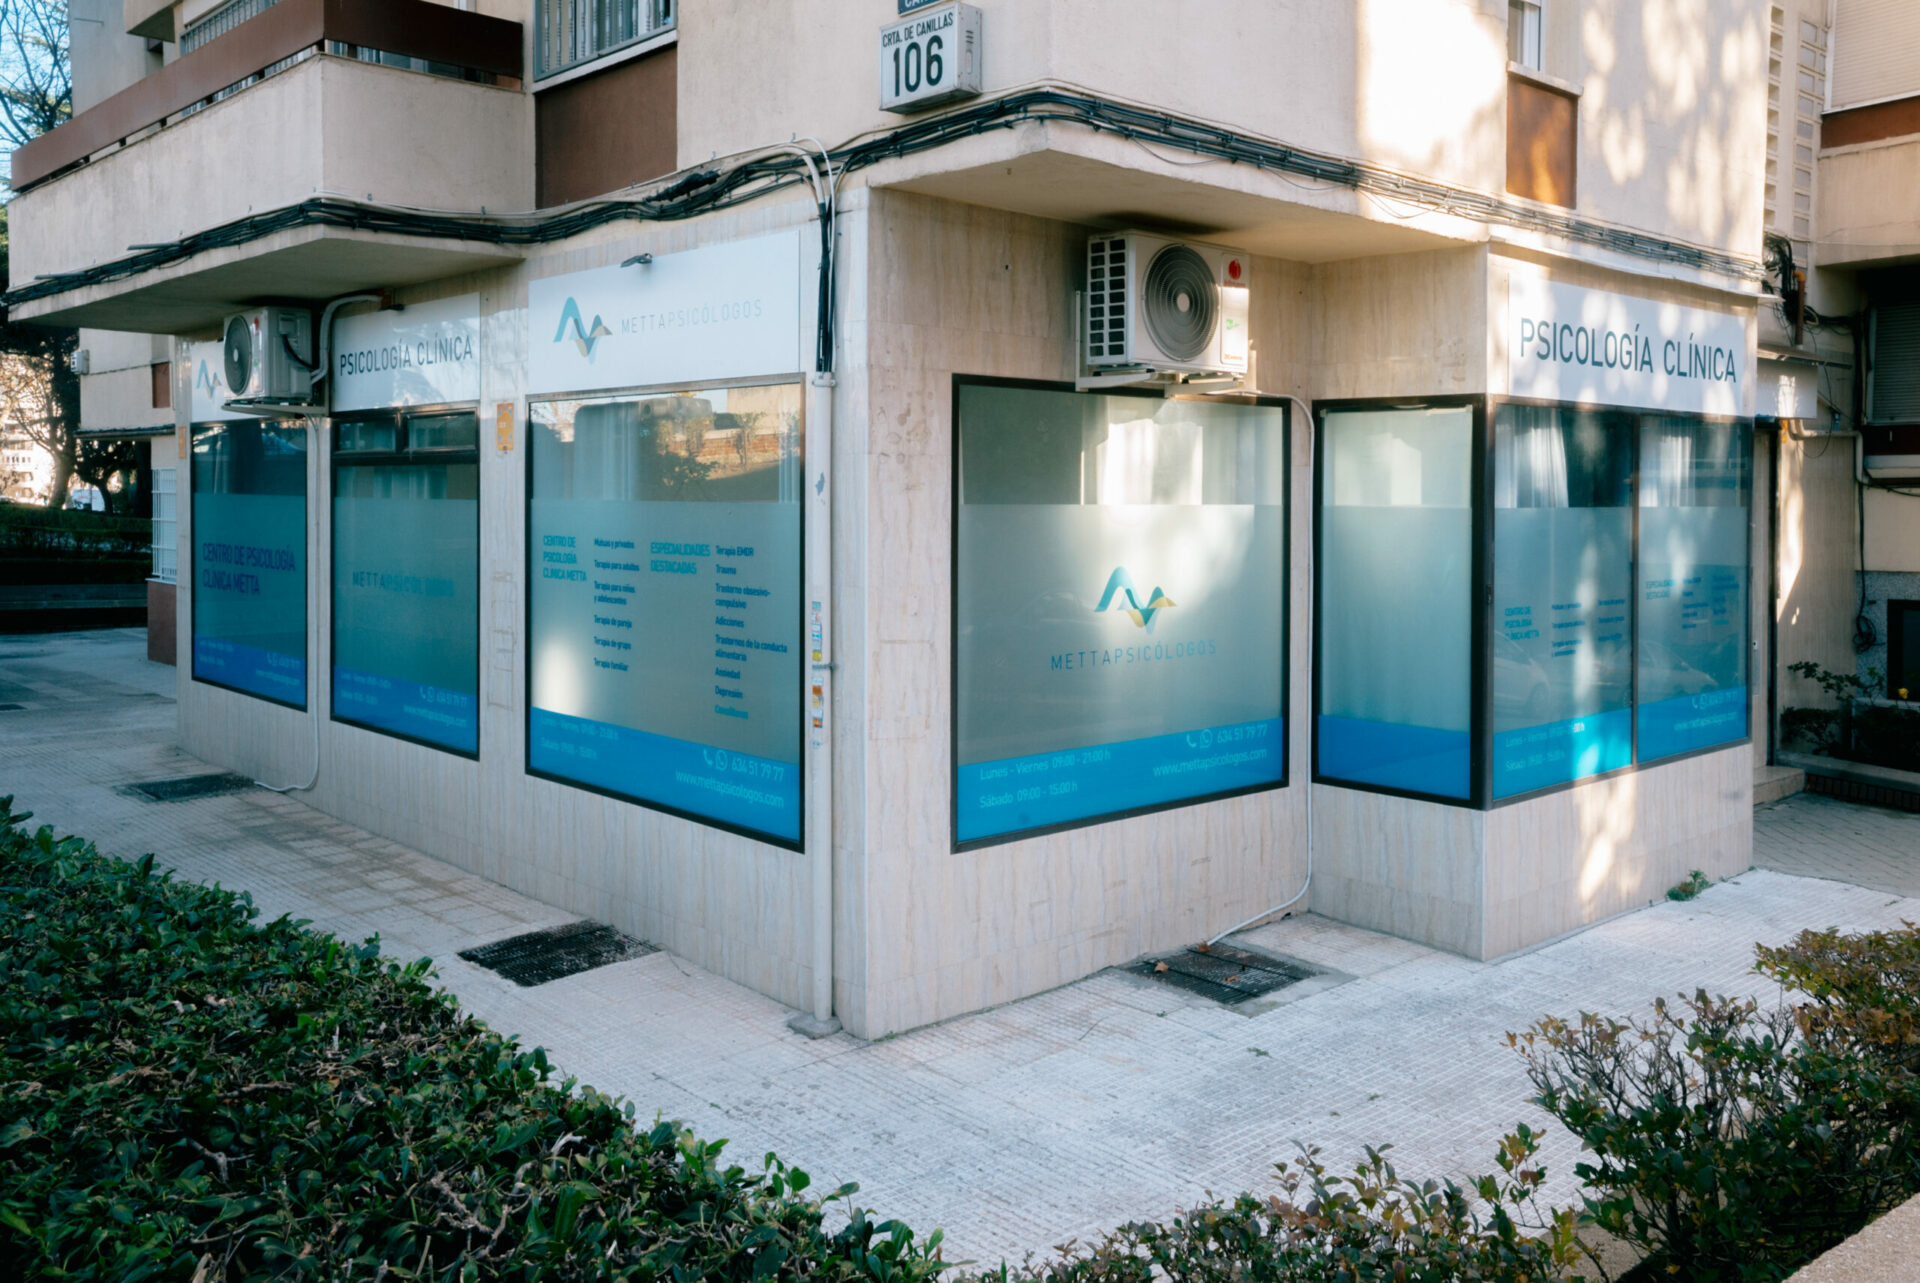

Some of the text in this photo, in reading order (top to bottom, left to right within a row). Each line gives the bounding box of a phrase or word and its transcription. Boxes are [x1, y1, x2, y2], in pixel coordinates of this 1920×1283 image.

[882, 12, 954, 48] CRTA. DE CANILLAS
[894, 34, 943, 97] 106
[621, 298, 763, 336] METTAPSICÓLOGOS
[340, 332, 473, 377] PSICOLOGÍA CLÍNICA
[1520, 318, 1737, 384] PSICOLOGÍA CLÍNICA
[202, 542, 296, 572] CENTRO DE PSICOLOGÍA
[203, 566, 260, 596] CLÍNICA METTA
[746, 638, 753, 648] de
[754, 639, 760, 649] la
[761, 641, 788, 653] conducta
[1050, 639, 1217, 672] METTAPSICÓLOGOS
[1217, 723, 1268, 744] 634 51 79 77
[731, 756, 784, 782] 634 51 79 77
[980, 766, 1008, 780] Lunes
[1016, 760, 1049, 774] Viernes
[1052, 754, 1075, 768] 09:00
[1082, 750, 1103, 764] 21:00
[1104, 747, 1111, 760] h
[1152, 748, 1268, 777] www.mettapsicologos.com
[675, 768, 784, 808] www.mettapsicologos.com
[979, 792, 1014, 808] Sábado
[1017, 786, 1041, 802] 09:00
[1049, 782, 1070, 795] 15:00
[1072, 780, 1078, 792] h
